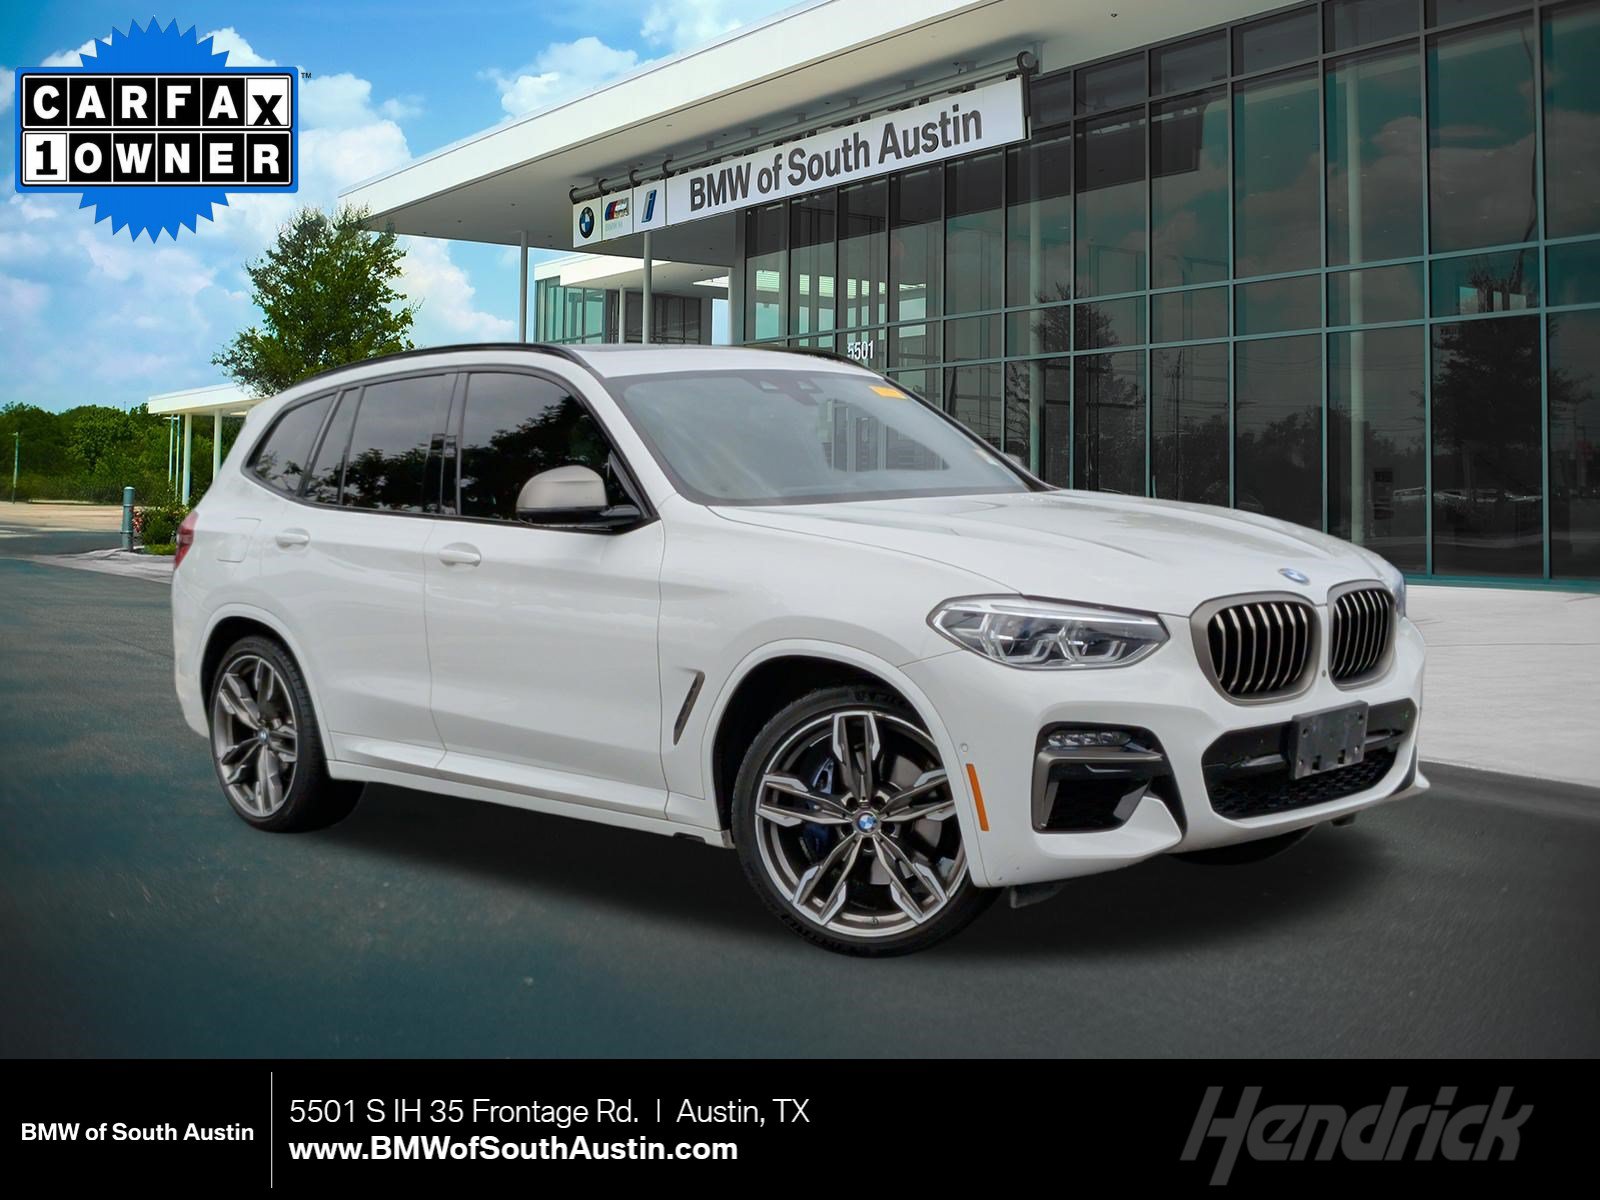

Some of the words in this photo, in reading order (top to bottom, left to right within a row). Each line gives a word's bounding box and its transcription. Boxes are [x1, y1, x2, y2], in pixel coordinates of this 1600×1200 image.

[690, 162, 751, 212] BMW
[757, 153, 783, 194] of
[787, 132, 870, 187] South
[878, 104, 983, 164] Austin
[847, 340, 874, 360] 5501
